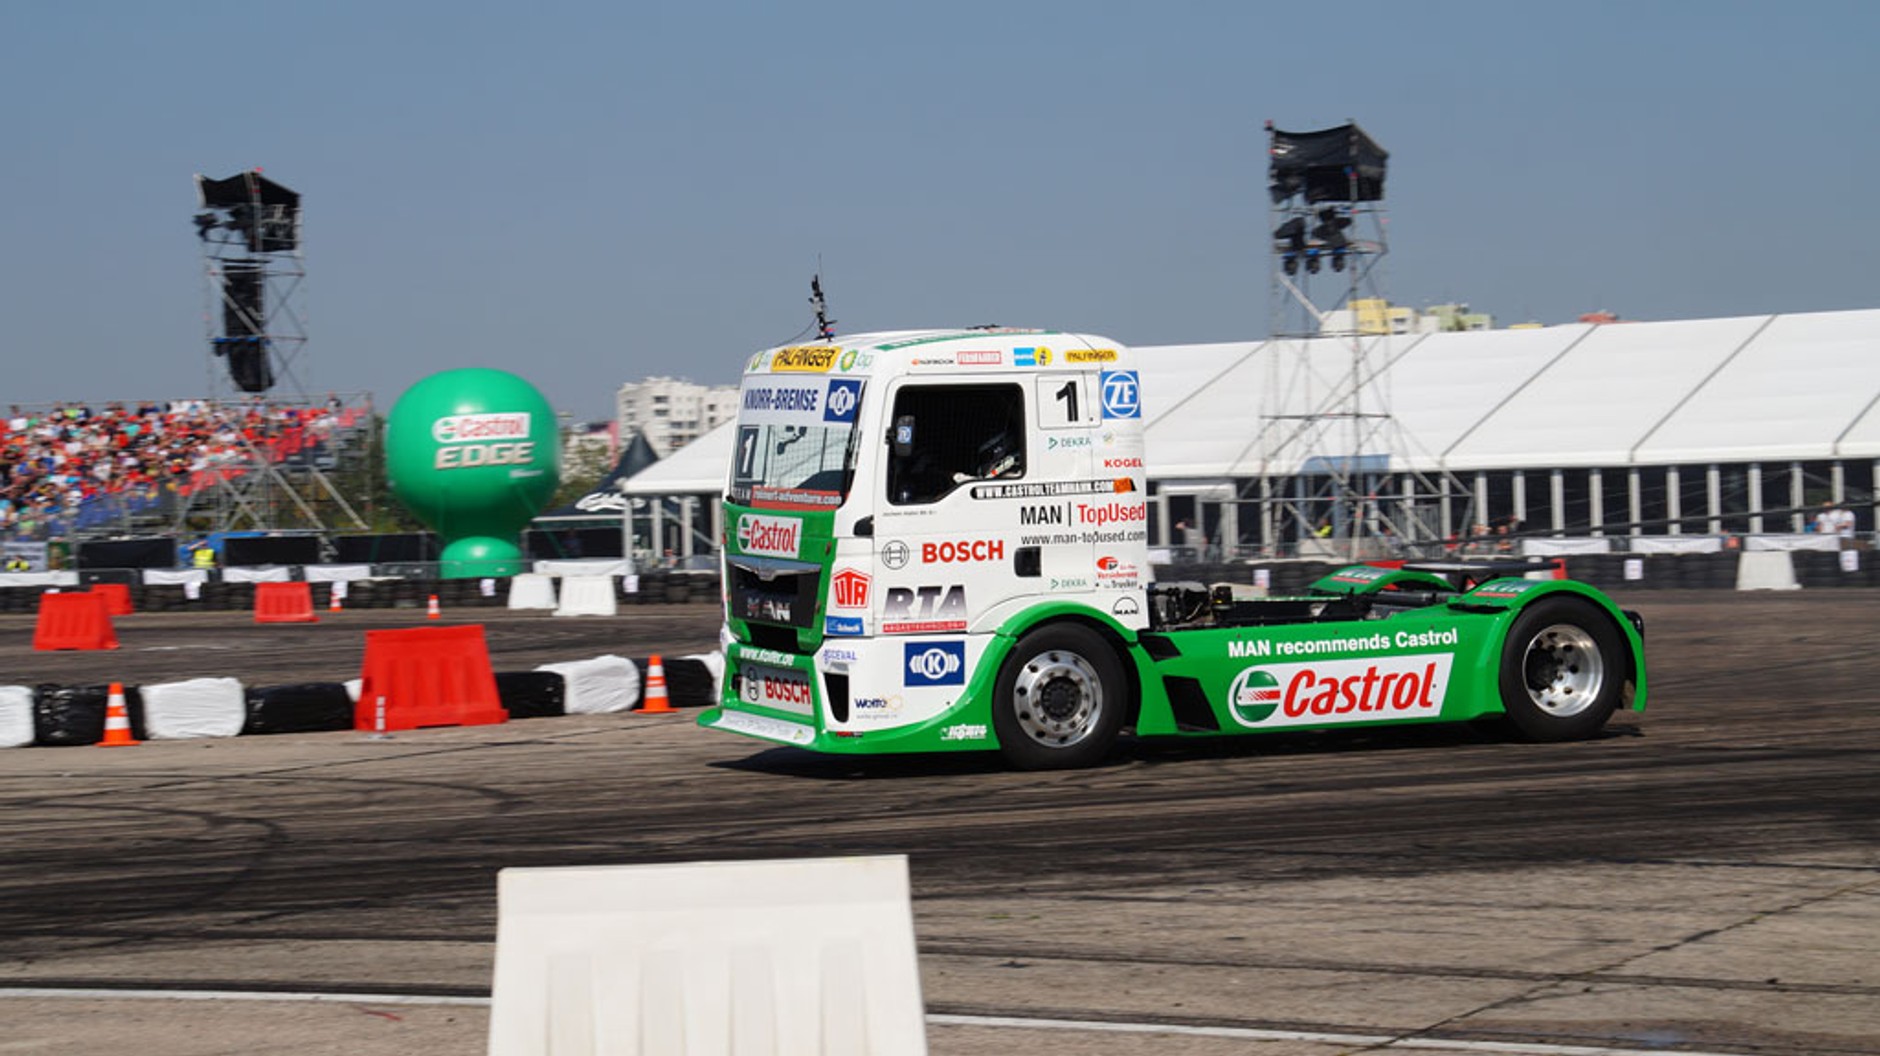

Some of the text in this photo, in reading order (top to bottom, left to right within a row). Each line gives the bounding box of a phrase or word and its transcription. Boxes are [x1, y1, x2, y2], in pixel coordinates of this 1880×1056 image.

[745, 388, 818, 411] KNORR-BREMSE
[1055, 381, 1079, 422] 1
[1109, 381, 1137, 408] ZF
[460, 417, 524, 438] Castrol
[435, 442, 536, 470] EDGE
[744, 434, 754, 473] 1
[1061, 438, 1091, 448] DEKRA
[1020, 502, 1146, 527] MAN TopUsed
[750, 518, 797, 552] Castrol
[1021, 530, 1146, 546] www.man-topused.com
[922, 540, 1004, 564] BOSCH
[834, 571, 868, 606] UTA
[1062, 578, 1088, 588] DEKRA
[884, 585, 968, 620] RTA
[1228, 628, 1458, 658] MAN recommends Castrol
[764, 676, 811, 704] BOSCH
[1283, 662, 1437, 718] Castrol
